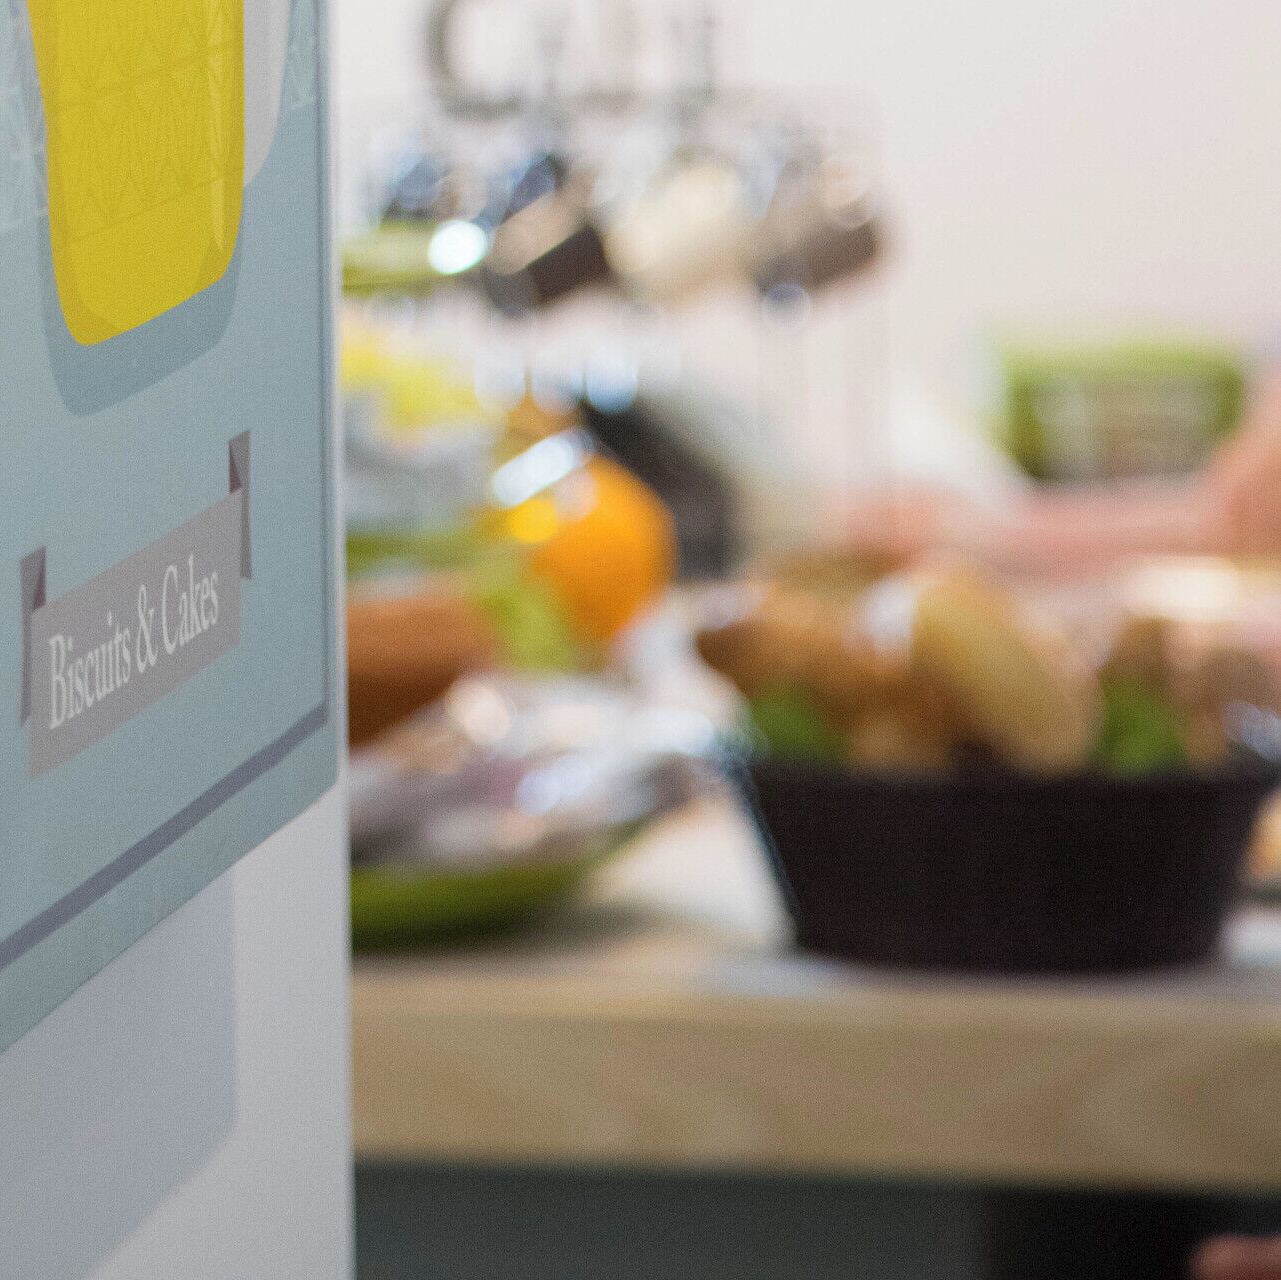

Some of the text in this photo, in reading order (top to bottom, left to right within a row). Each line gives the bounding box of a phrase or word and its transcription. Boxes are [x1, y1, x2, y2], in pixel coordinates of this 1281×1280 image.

[48, 554, 220, 730] Biscuits & Cakes
